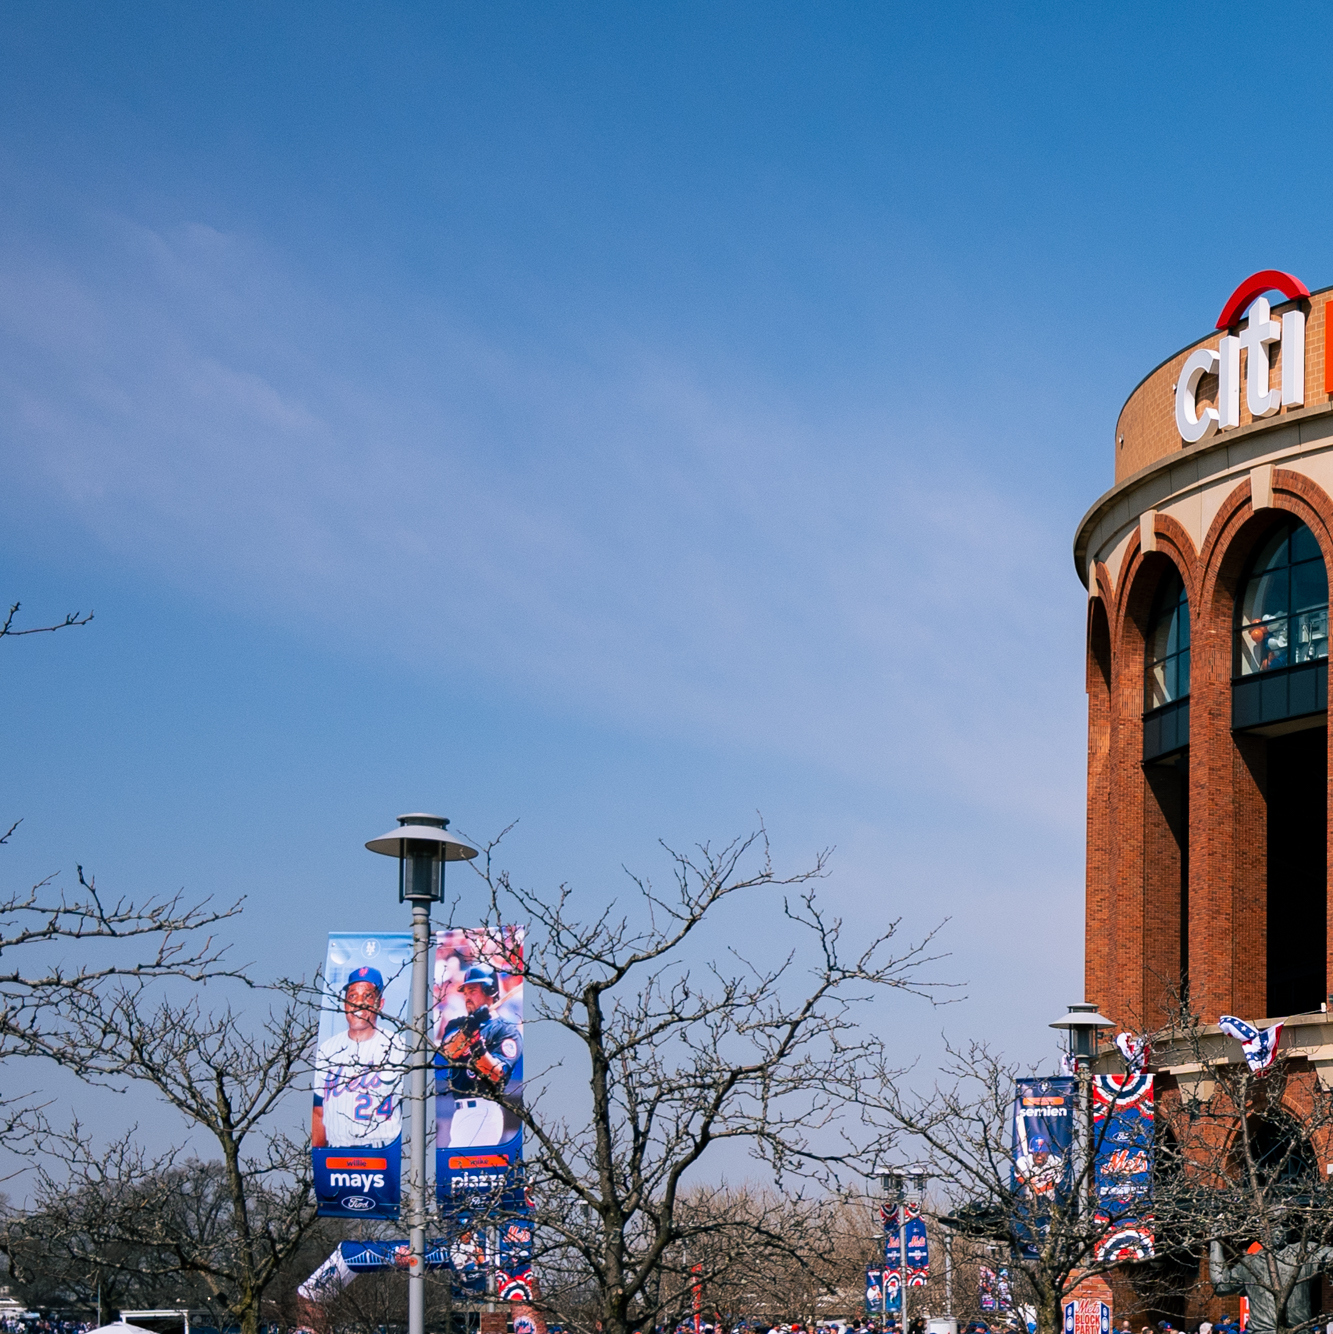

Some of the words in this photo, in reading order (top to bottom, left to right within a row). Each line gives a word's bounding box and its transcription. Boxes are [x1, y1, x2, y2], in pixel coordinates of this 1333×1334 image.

[1175, 292, 1306, 443] citi
[354, 1094, 395, 1121] 24
[1019, 1105, 1067, 1117] semien
[346, 1159, 367, 1167] willie
[1101, 1149, 1148, 1174] Mets
[330, 1172, 385, 1193] mays
[347, 1196, 370, 1208] Ford
[1075, 1299, 1100, 1314] Mets
[1075, 1314, 1100, 1324] BLOCK
[1075, 1325, 1100, 1334] PARTY
